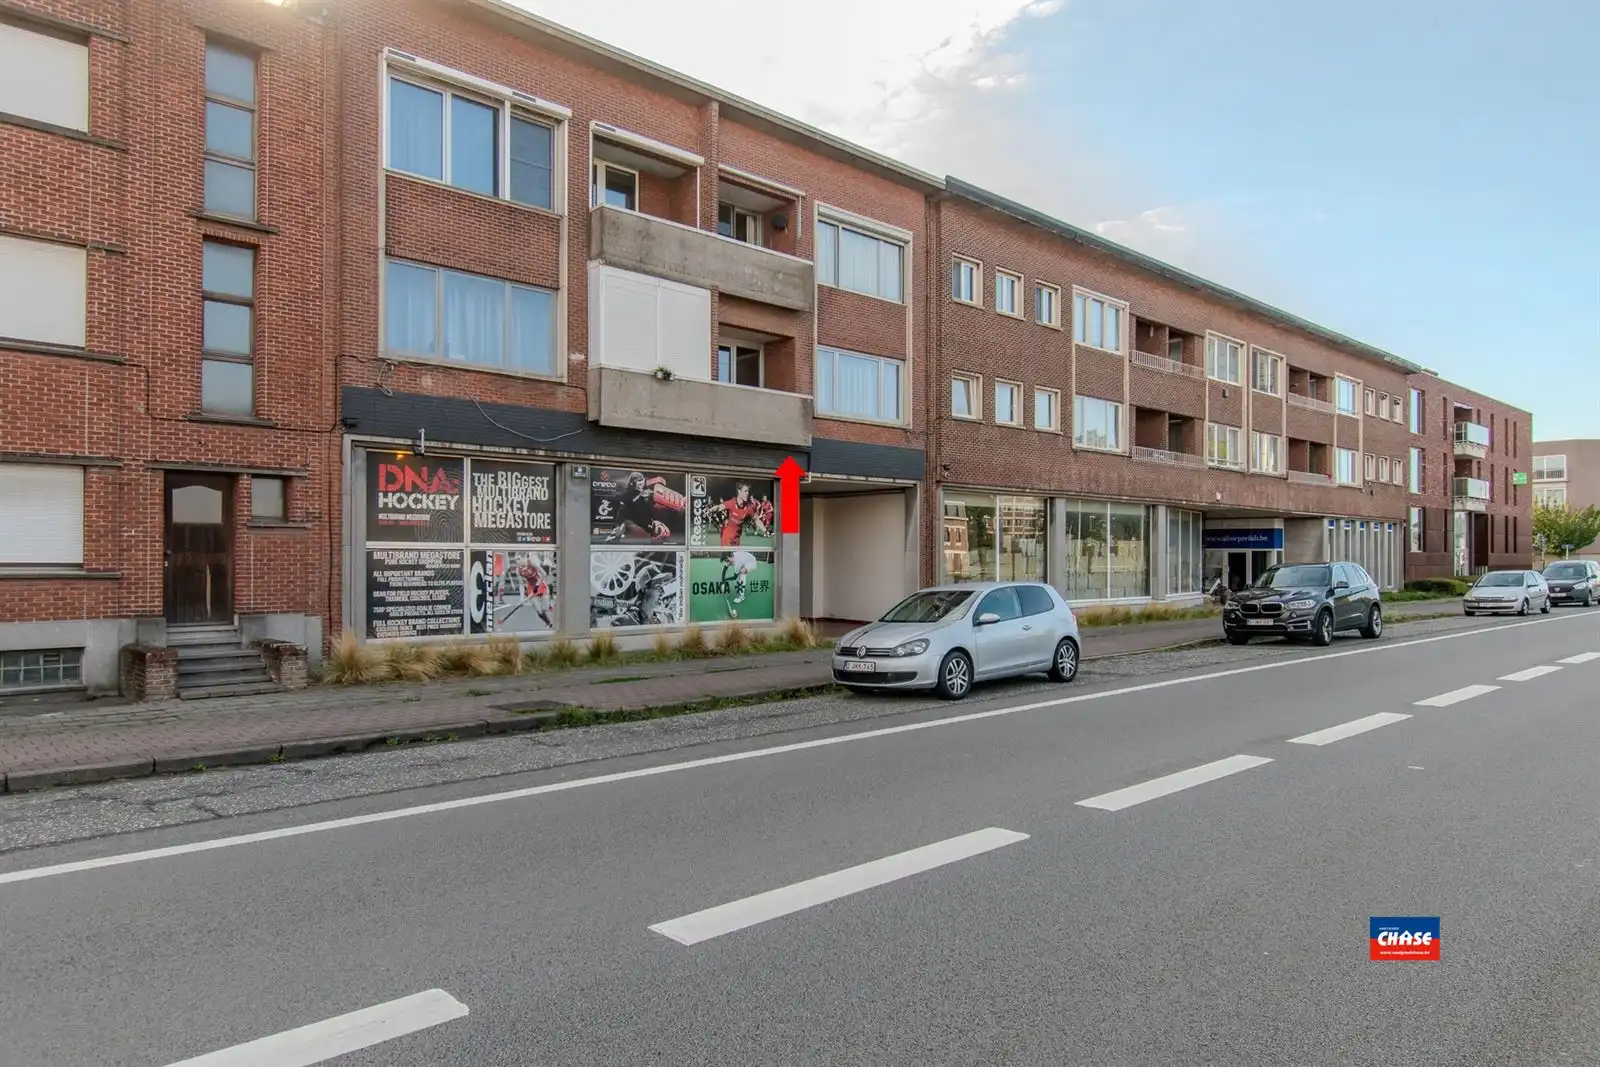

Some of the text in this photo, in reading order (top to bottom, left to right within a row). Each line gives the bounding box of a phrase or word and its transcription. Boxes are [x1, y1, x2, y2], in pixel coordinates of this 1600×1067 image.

[472, 472, 495, 487] THE
[378, 492, 460, 510] HOCKEY
[477, 485, 549, 501] MULTIBRAND
[472, 496, 529, 515] HOCKEY
[474, 512, 551, 529] MEGASTORE
[691, 499, 702, 545] Reece
[373, 551, 461, 560] MULTIBRAND MEGASTORE
[486, 550, 494, 633] mercian
[692, 581, 731, 595] OSAKA
[750, 579, 770, 593] 世界
[427, 616, 461, 624] COLLECTIONS
